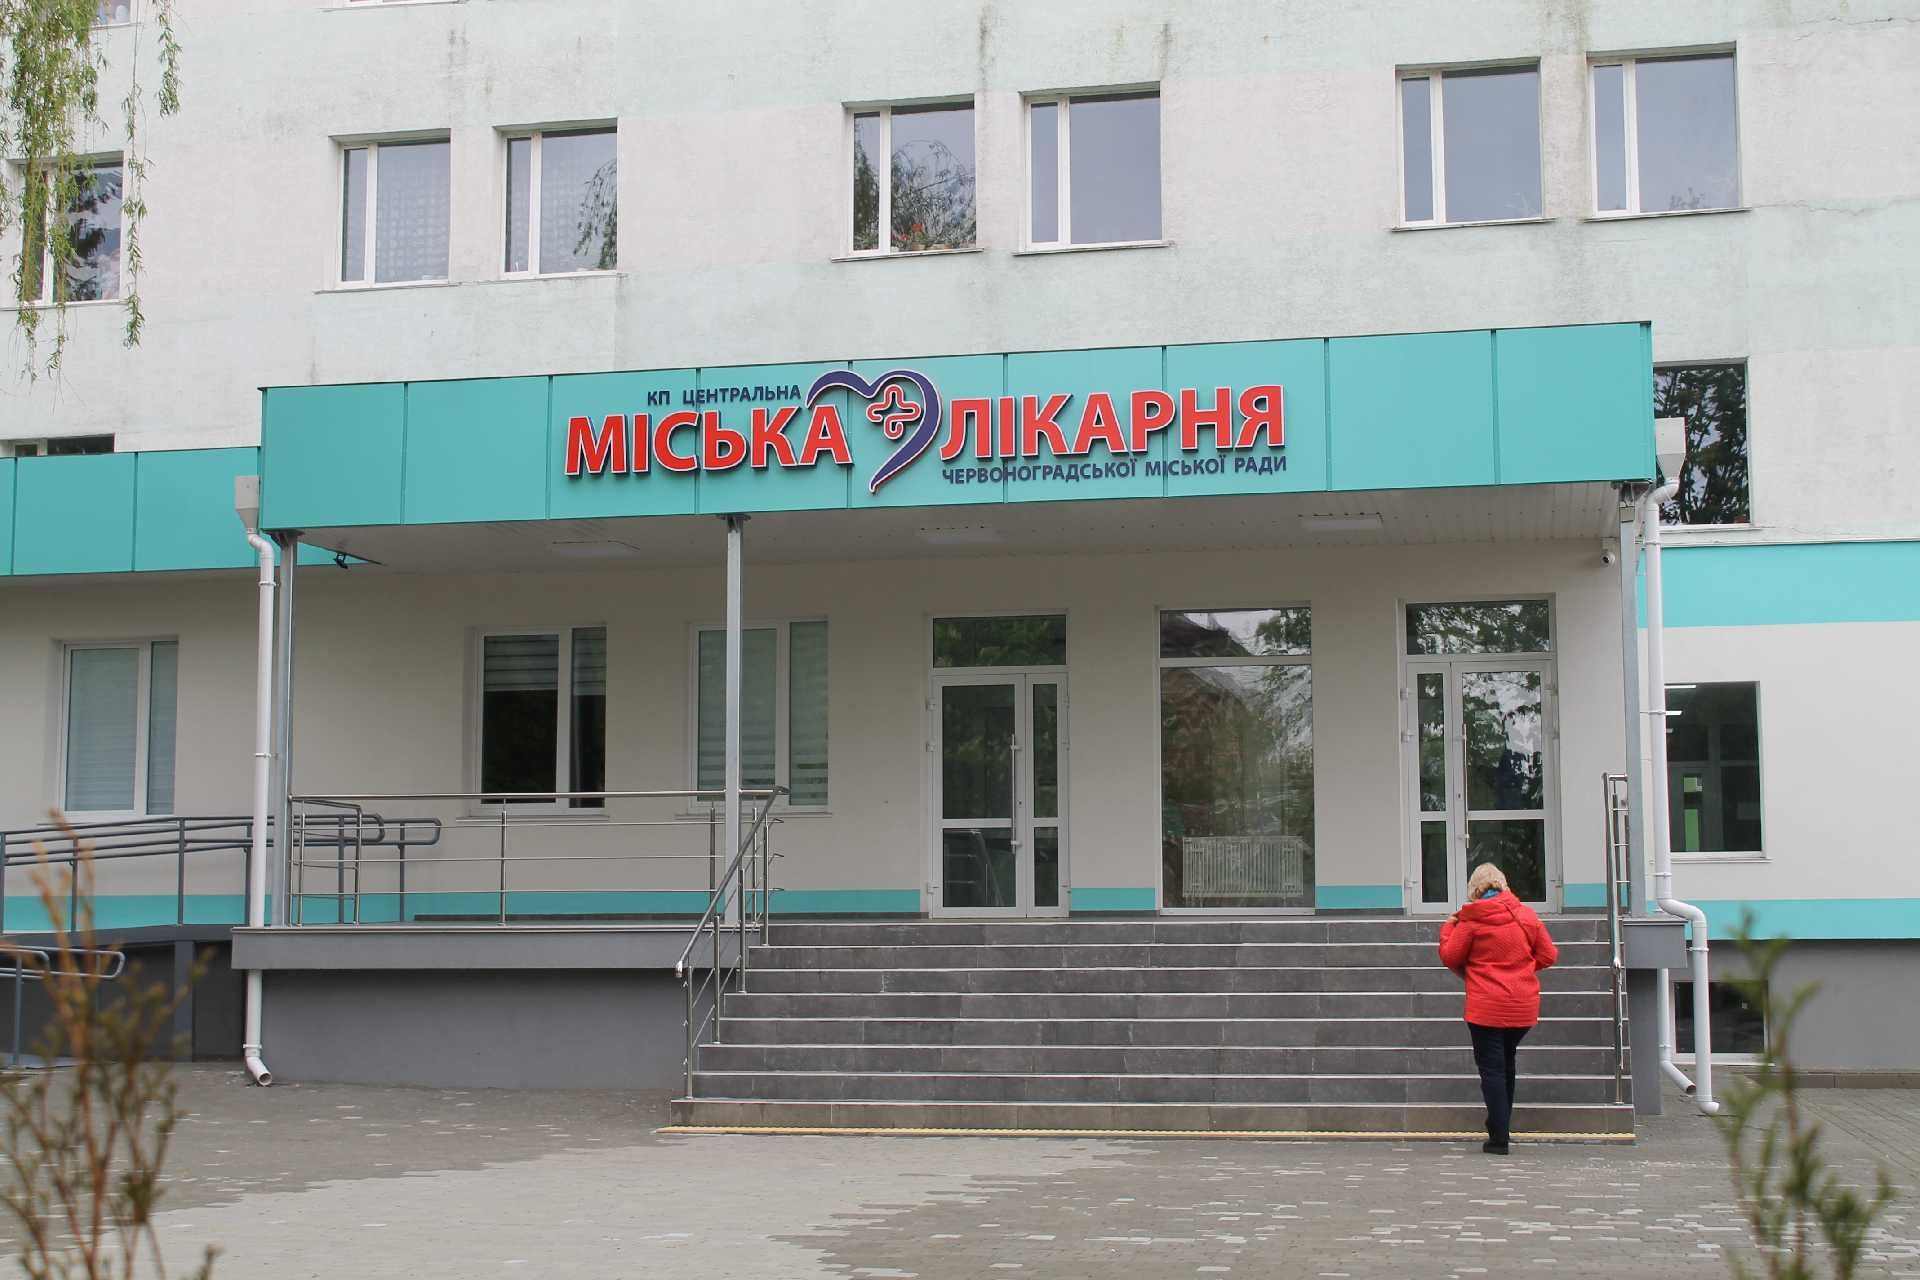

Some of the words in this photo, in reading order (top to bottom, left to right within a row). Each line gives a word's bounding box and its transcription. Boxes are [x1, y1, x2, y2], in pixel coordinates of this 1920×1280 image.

[648, 391, 670, 406] КП
[683, 384, 801, 406] ЦЕНТРАЛЬНА
[565, 404, 853, 476] МІСЬКА
[939, 384, 1286, 461] ЛІКАРНЯ
[942, 458, 1137, 485] ЧЕРВОНОГРАДСЬКОЇ
[1145, 453, 1225, 477] МІСЬКОЇ
[1234, 455, 1287, 474] РАДИ
